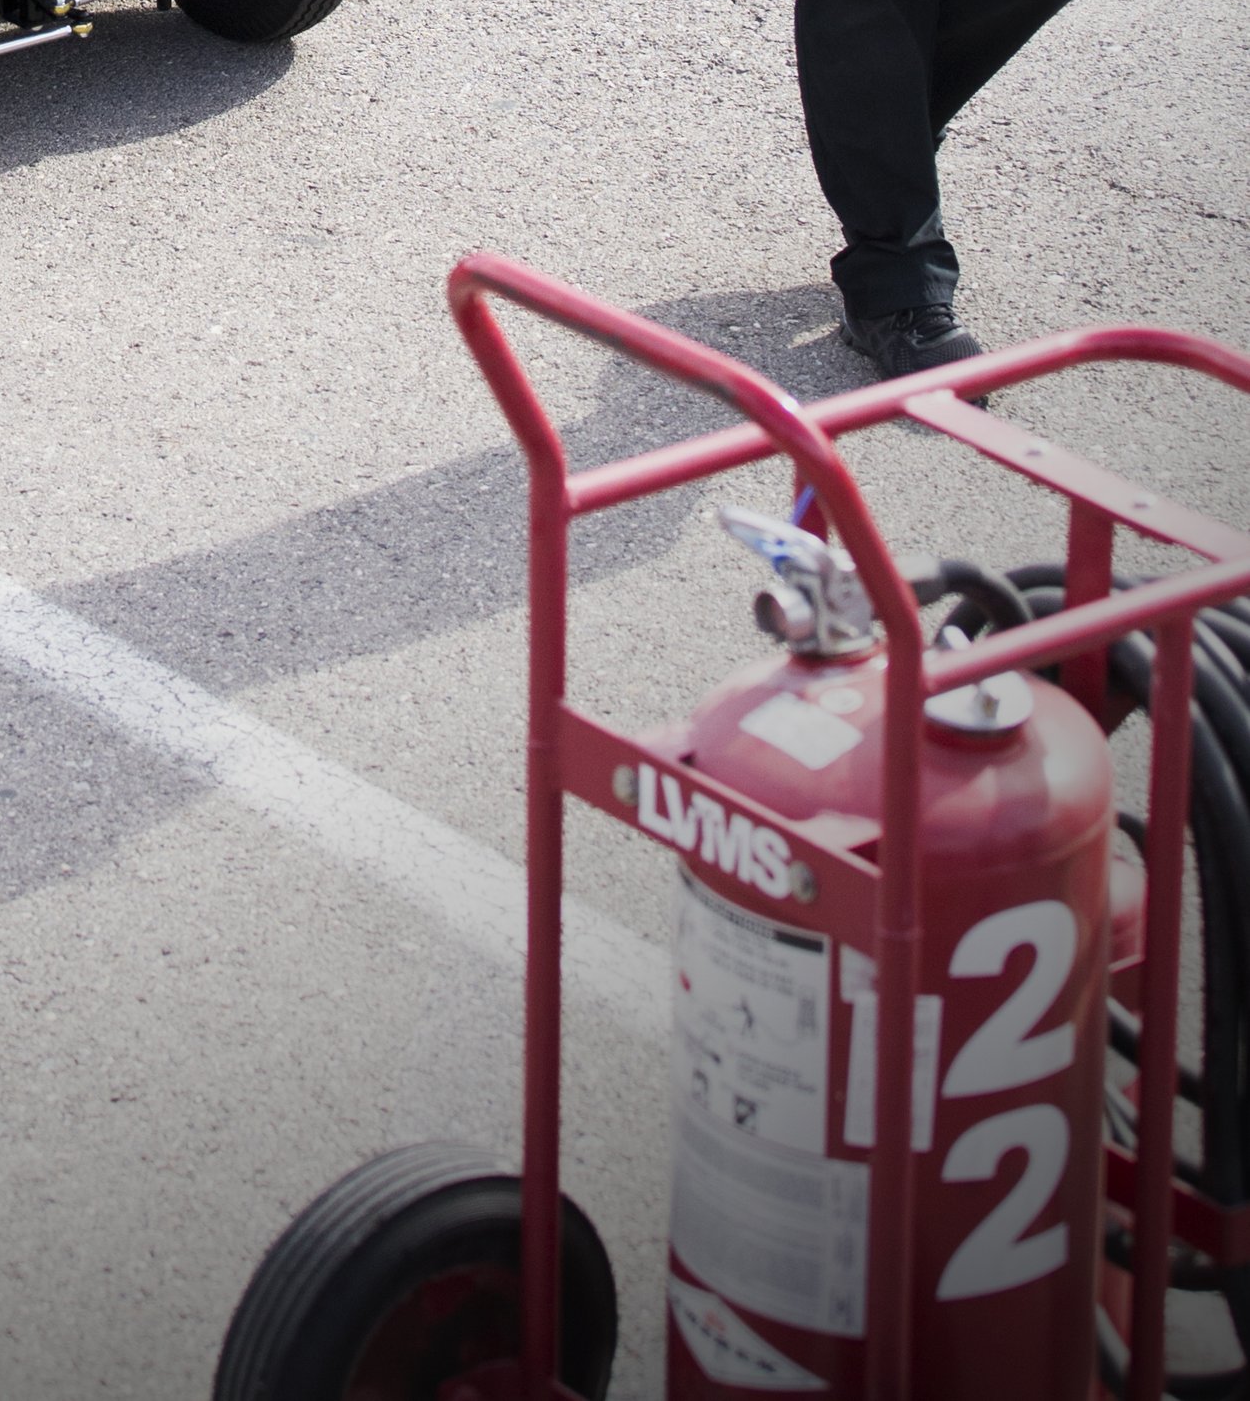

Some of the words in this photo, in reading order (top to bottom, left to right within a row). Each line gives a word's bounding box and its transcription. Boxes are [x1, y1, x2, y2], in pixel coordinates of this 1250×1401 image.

[637, 763, 795, 900] LVMS
[941, 899, 1078, 1098] 2
[935, 1102, 1071, 1301] 2
